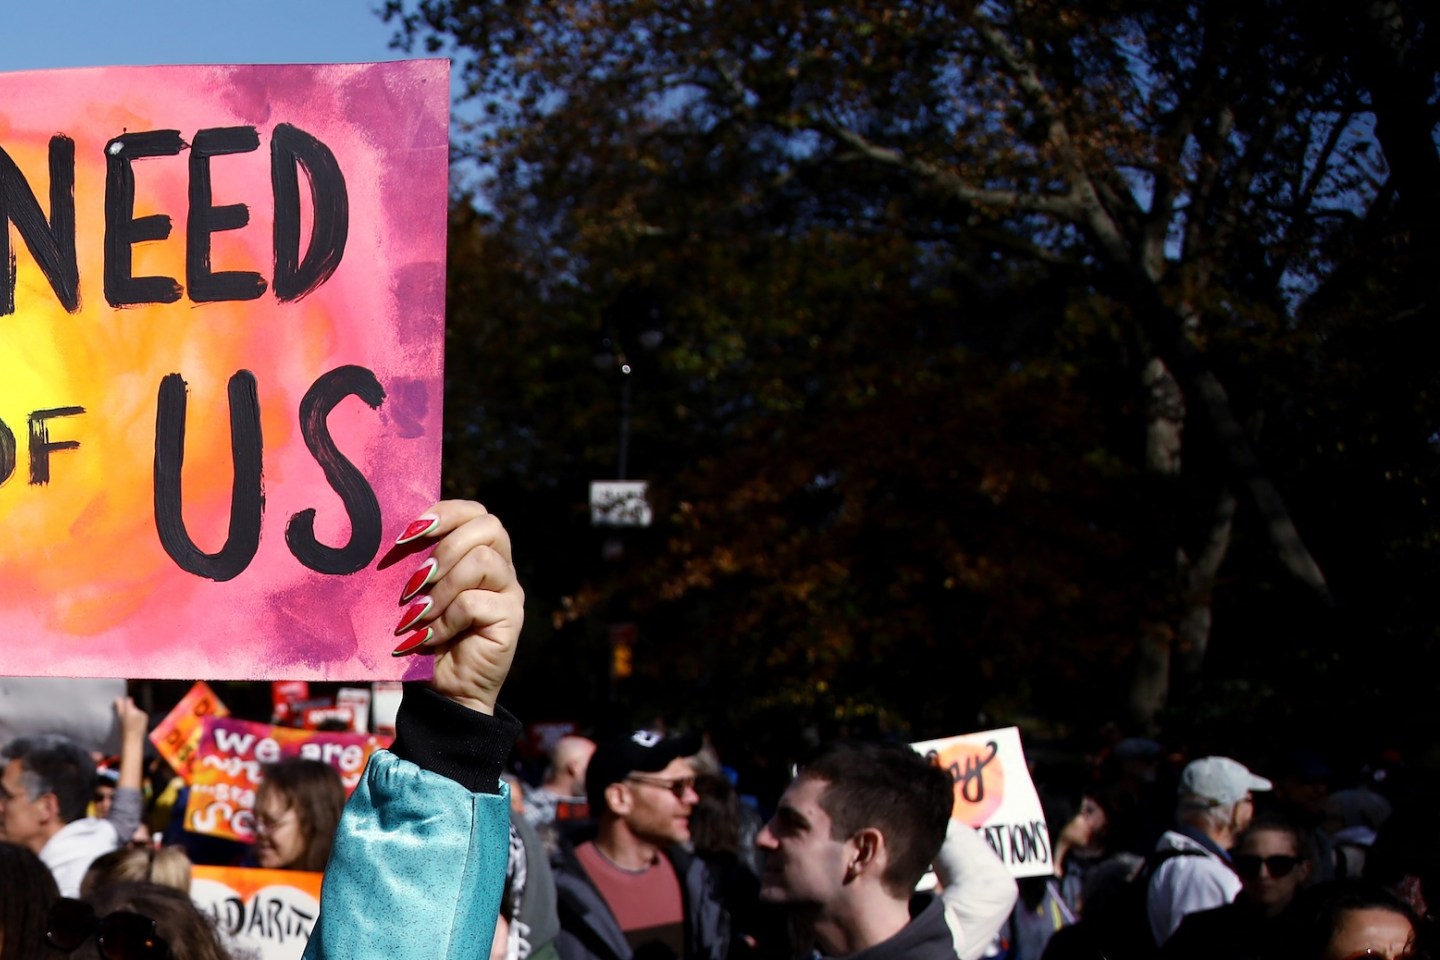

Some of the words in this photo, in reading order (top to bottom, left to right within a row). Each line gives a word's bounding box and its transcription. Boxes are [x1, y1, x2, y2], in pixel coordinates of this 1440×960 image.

[154, 363, 388, 583] US
[213, 727, 282, 766] we
[300, 741, 364, 773] are
